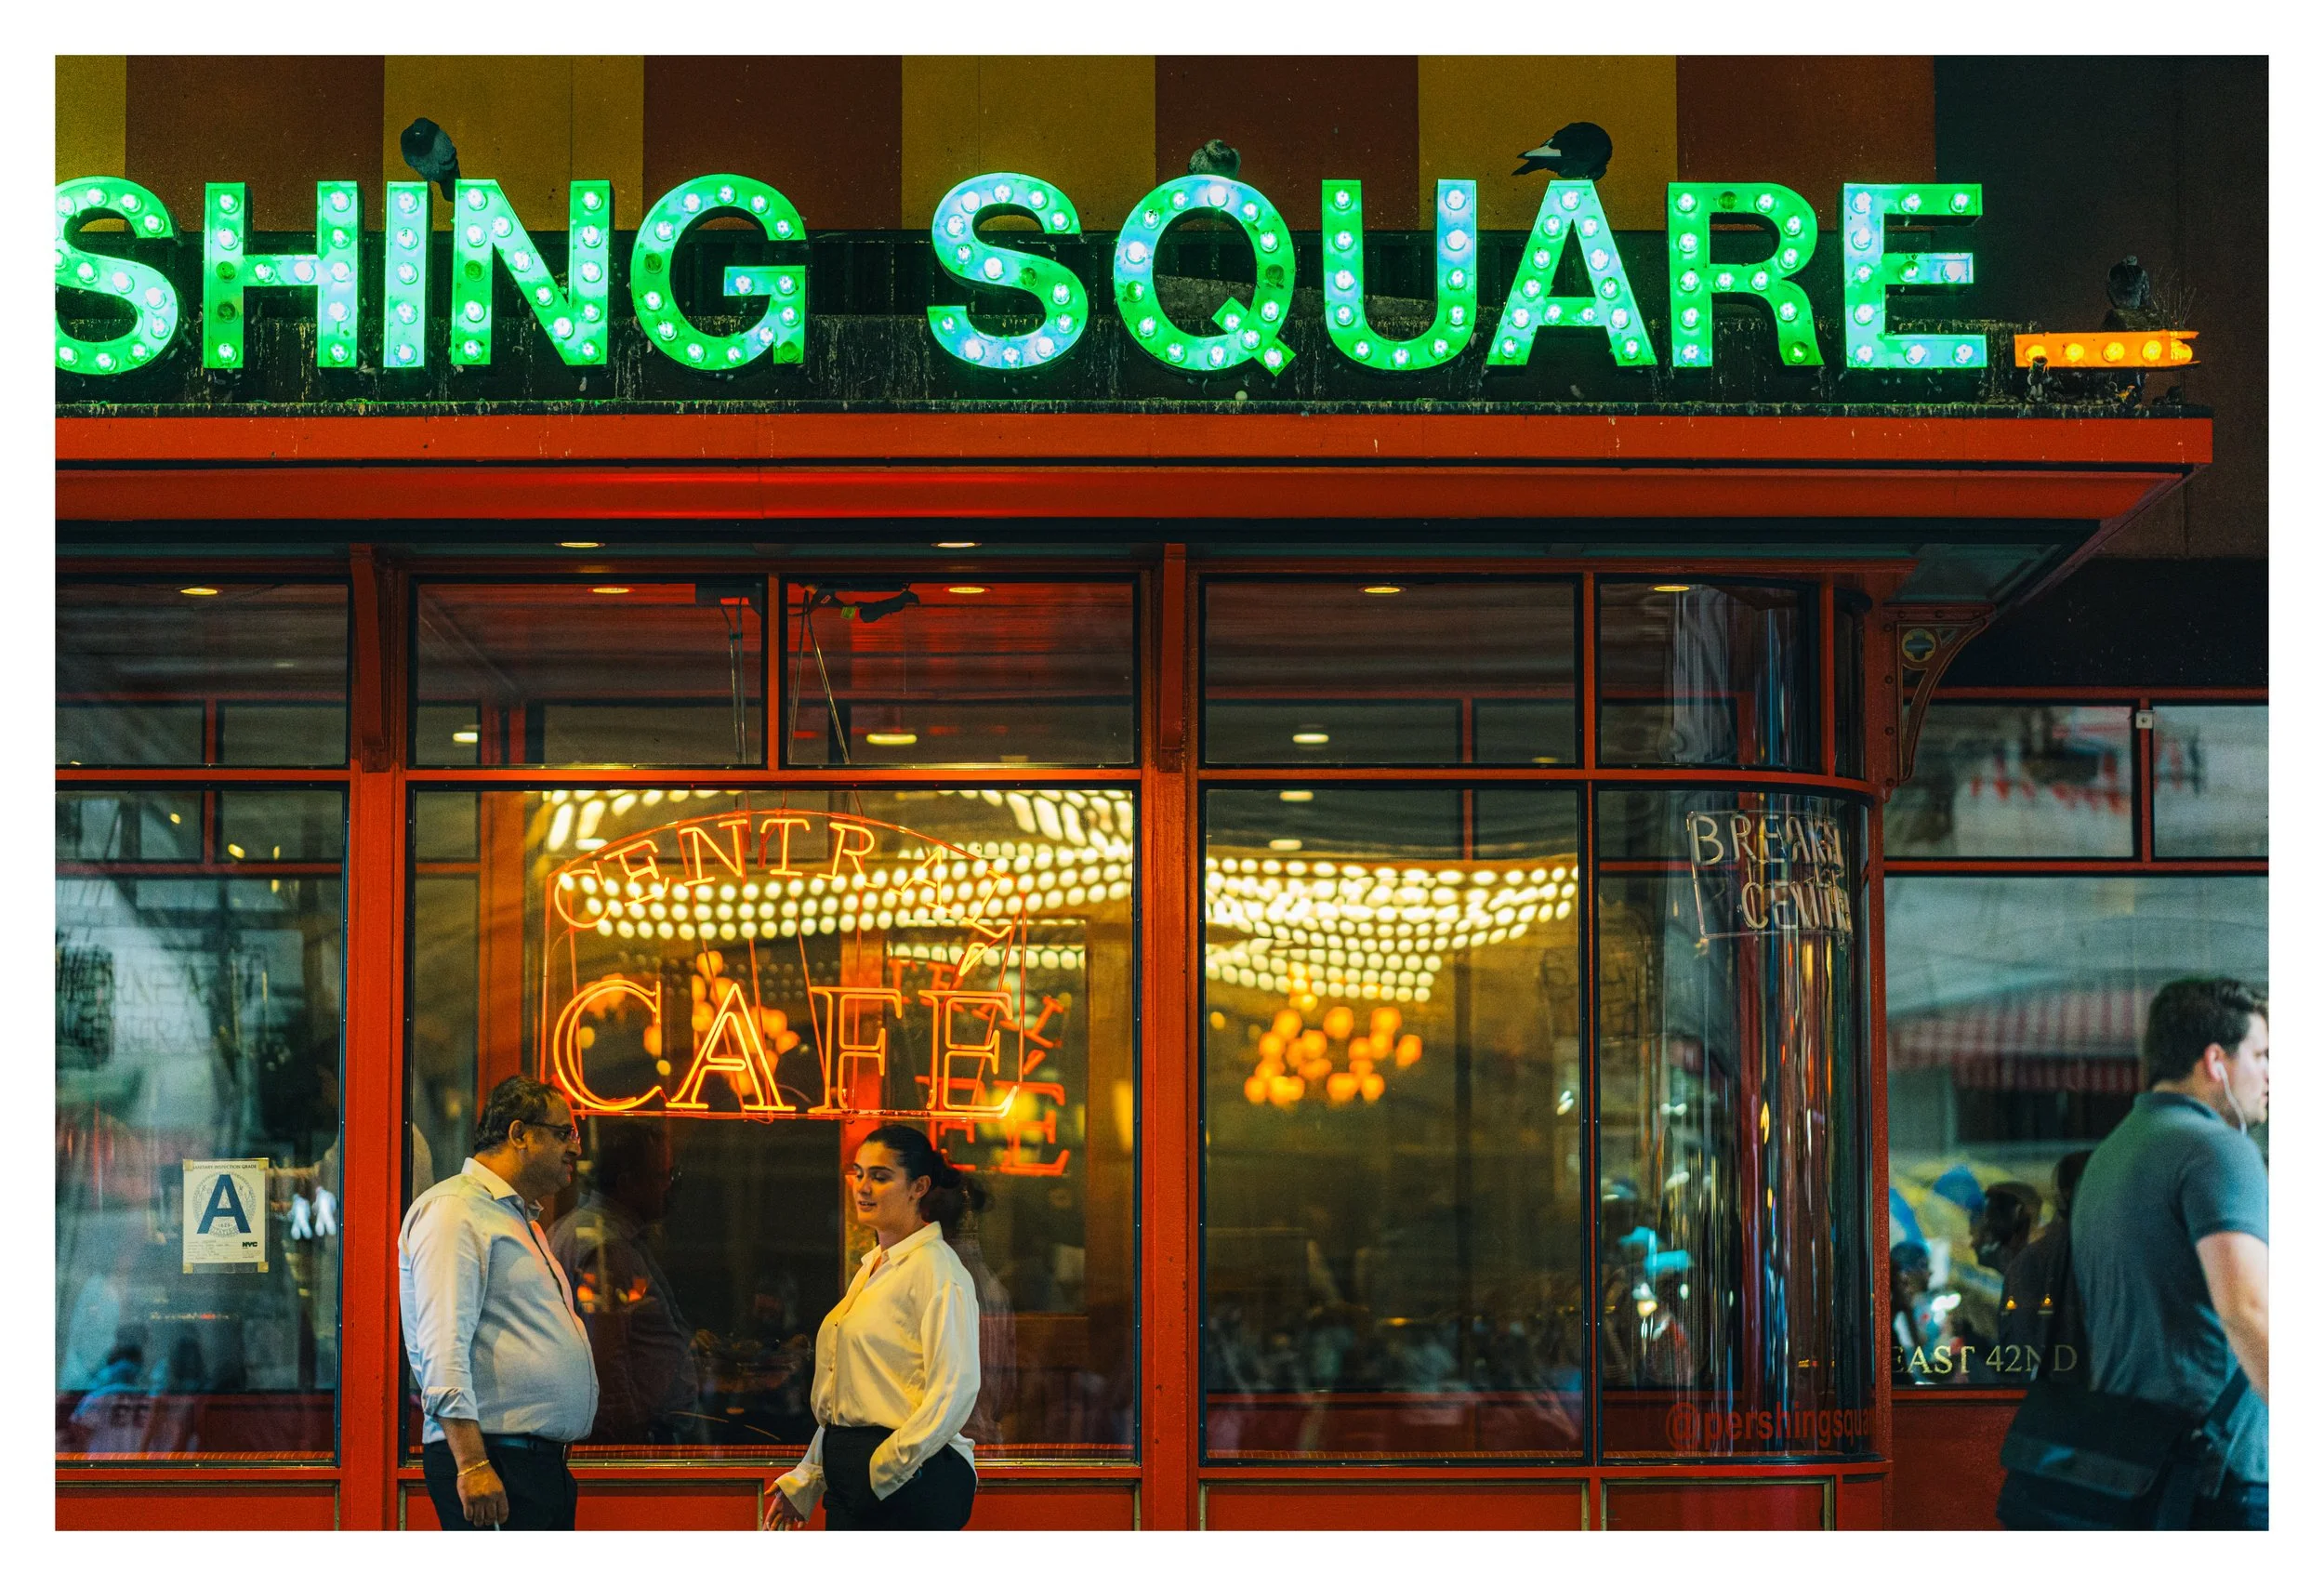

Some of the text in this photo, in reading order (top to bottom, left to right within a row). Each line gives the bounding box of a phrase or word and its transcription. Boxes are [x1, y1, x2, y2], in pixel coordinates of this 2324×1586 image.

[55, 172, 1988, 377] SHING SQUARE
[554, 816, 1014, 939] CENTRAL
[196, 1174, 252, 1234] A
[1985, 1344, 2079, 1373] 42ND
